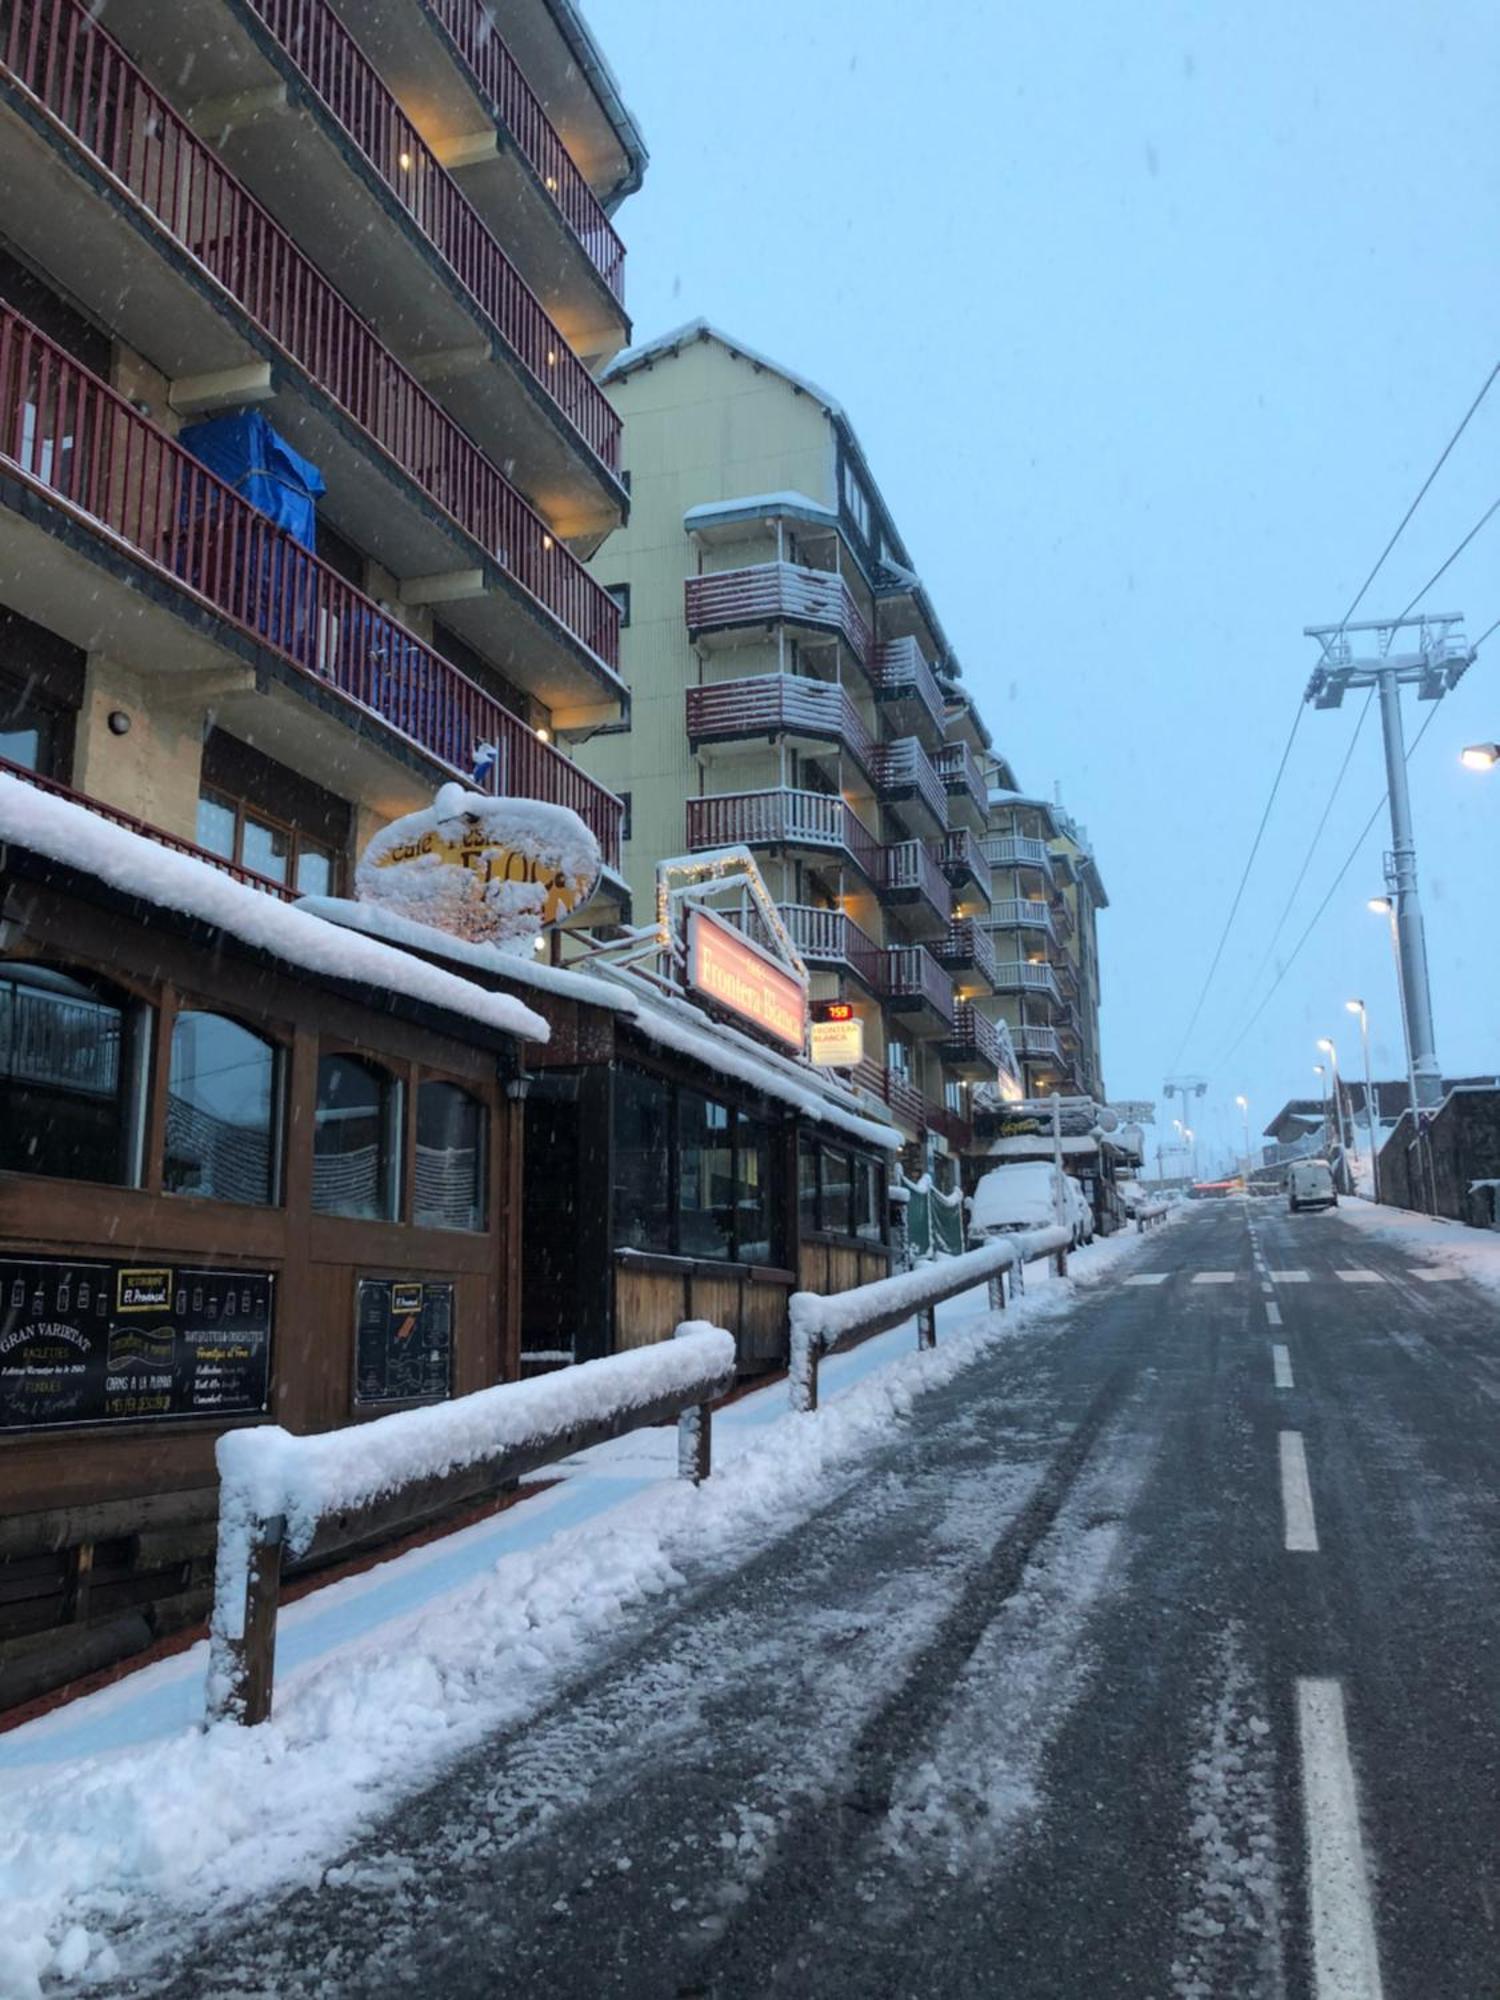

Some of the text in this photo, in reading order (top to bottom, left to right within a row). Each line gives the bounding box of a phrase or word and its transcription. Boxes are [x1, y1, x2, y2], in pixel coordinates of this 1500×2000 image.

[813, 1034, 848, 1042] BLANCA
[0, 1323, 36, 1353] GRAN
[37, 1322, 92, 1352] VARIETAT
[130, 1376, 137, 1390] A
